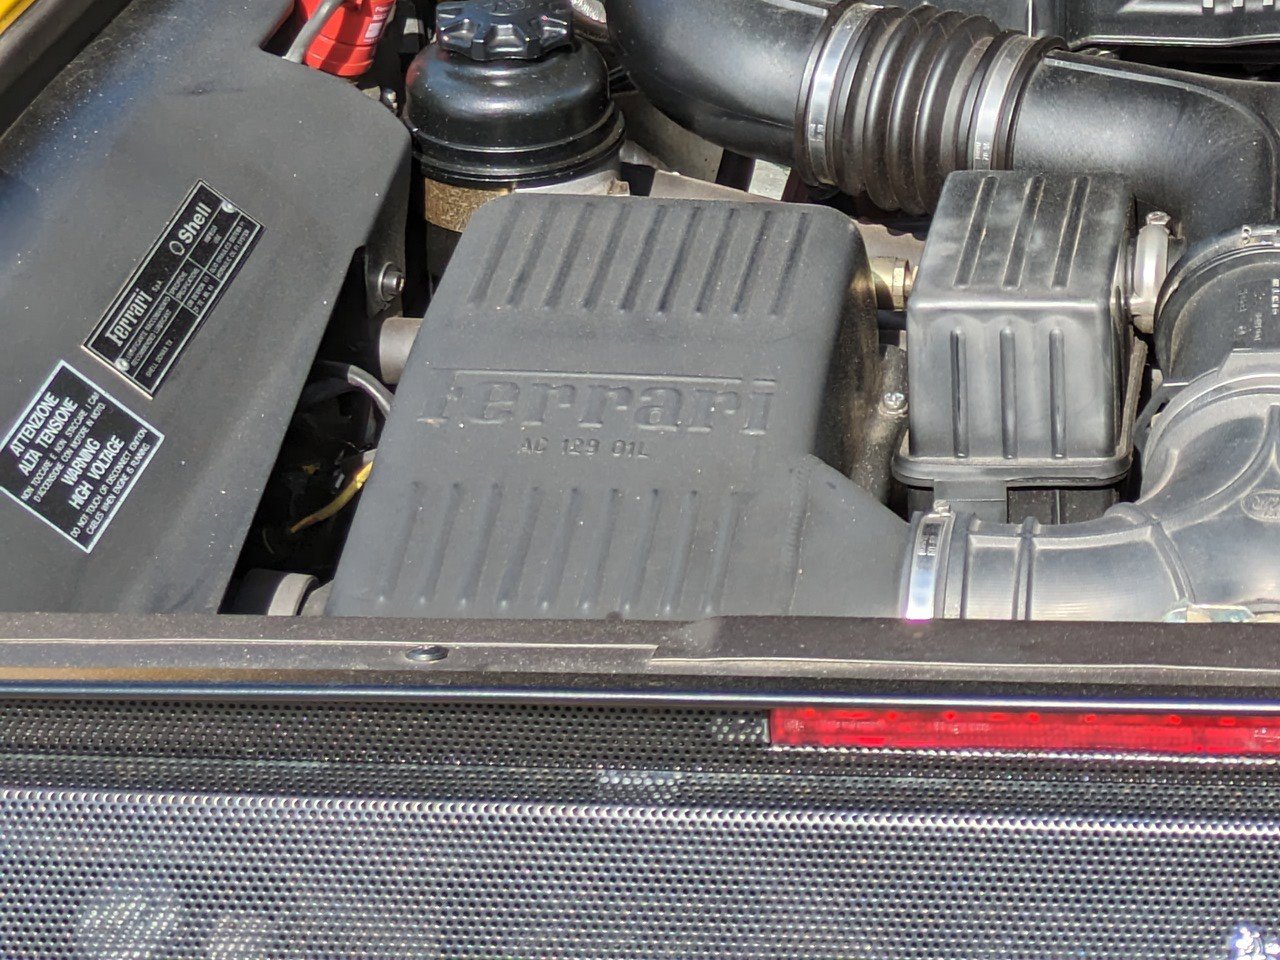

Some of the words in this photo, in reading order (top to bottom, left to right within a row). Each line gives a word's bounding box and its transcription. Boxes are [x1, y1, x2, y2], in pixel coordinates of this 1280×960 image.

[178, 202, 211, 244] Shell
[105, 288, 152, 346] Ferrari
[10, 392, 59, 456] ATTENZIONE
[416, 368, 776, 437] Ferrari
[18, 449, 43, 476] ALTA
[35, 397, 78, 448] TENSIONE
[20, 485, 35, 501] NON
[30, 459, 53, 486] TOCCARE
[54, 438, 67, 453] NON
[65, 409, 88, 438] STACCARE
[60, 447, 74, 463] CON
[70, 425, 90, 449] MOTORE
[61, 438, 100, 485] WARNING
[561, 438, 600, 456] 129
[68, 480, 94, 510] HIGH
[87, 435, 124, 479] VOLTAGE
[77, 513, 89, 528] NOT
[85, 494, 103, 515] TOUCH
[105, 450, 131, 485] DISCONNECT
[129, 427, 148, 451] IGNITION
[86, 511, 104, 535] CABLES
[101, 493, 117, 512] WHEN
[112, 473, 130, 495] ENGINE
